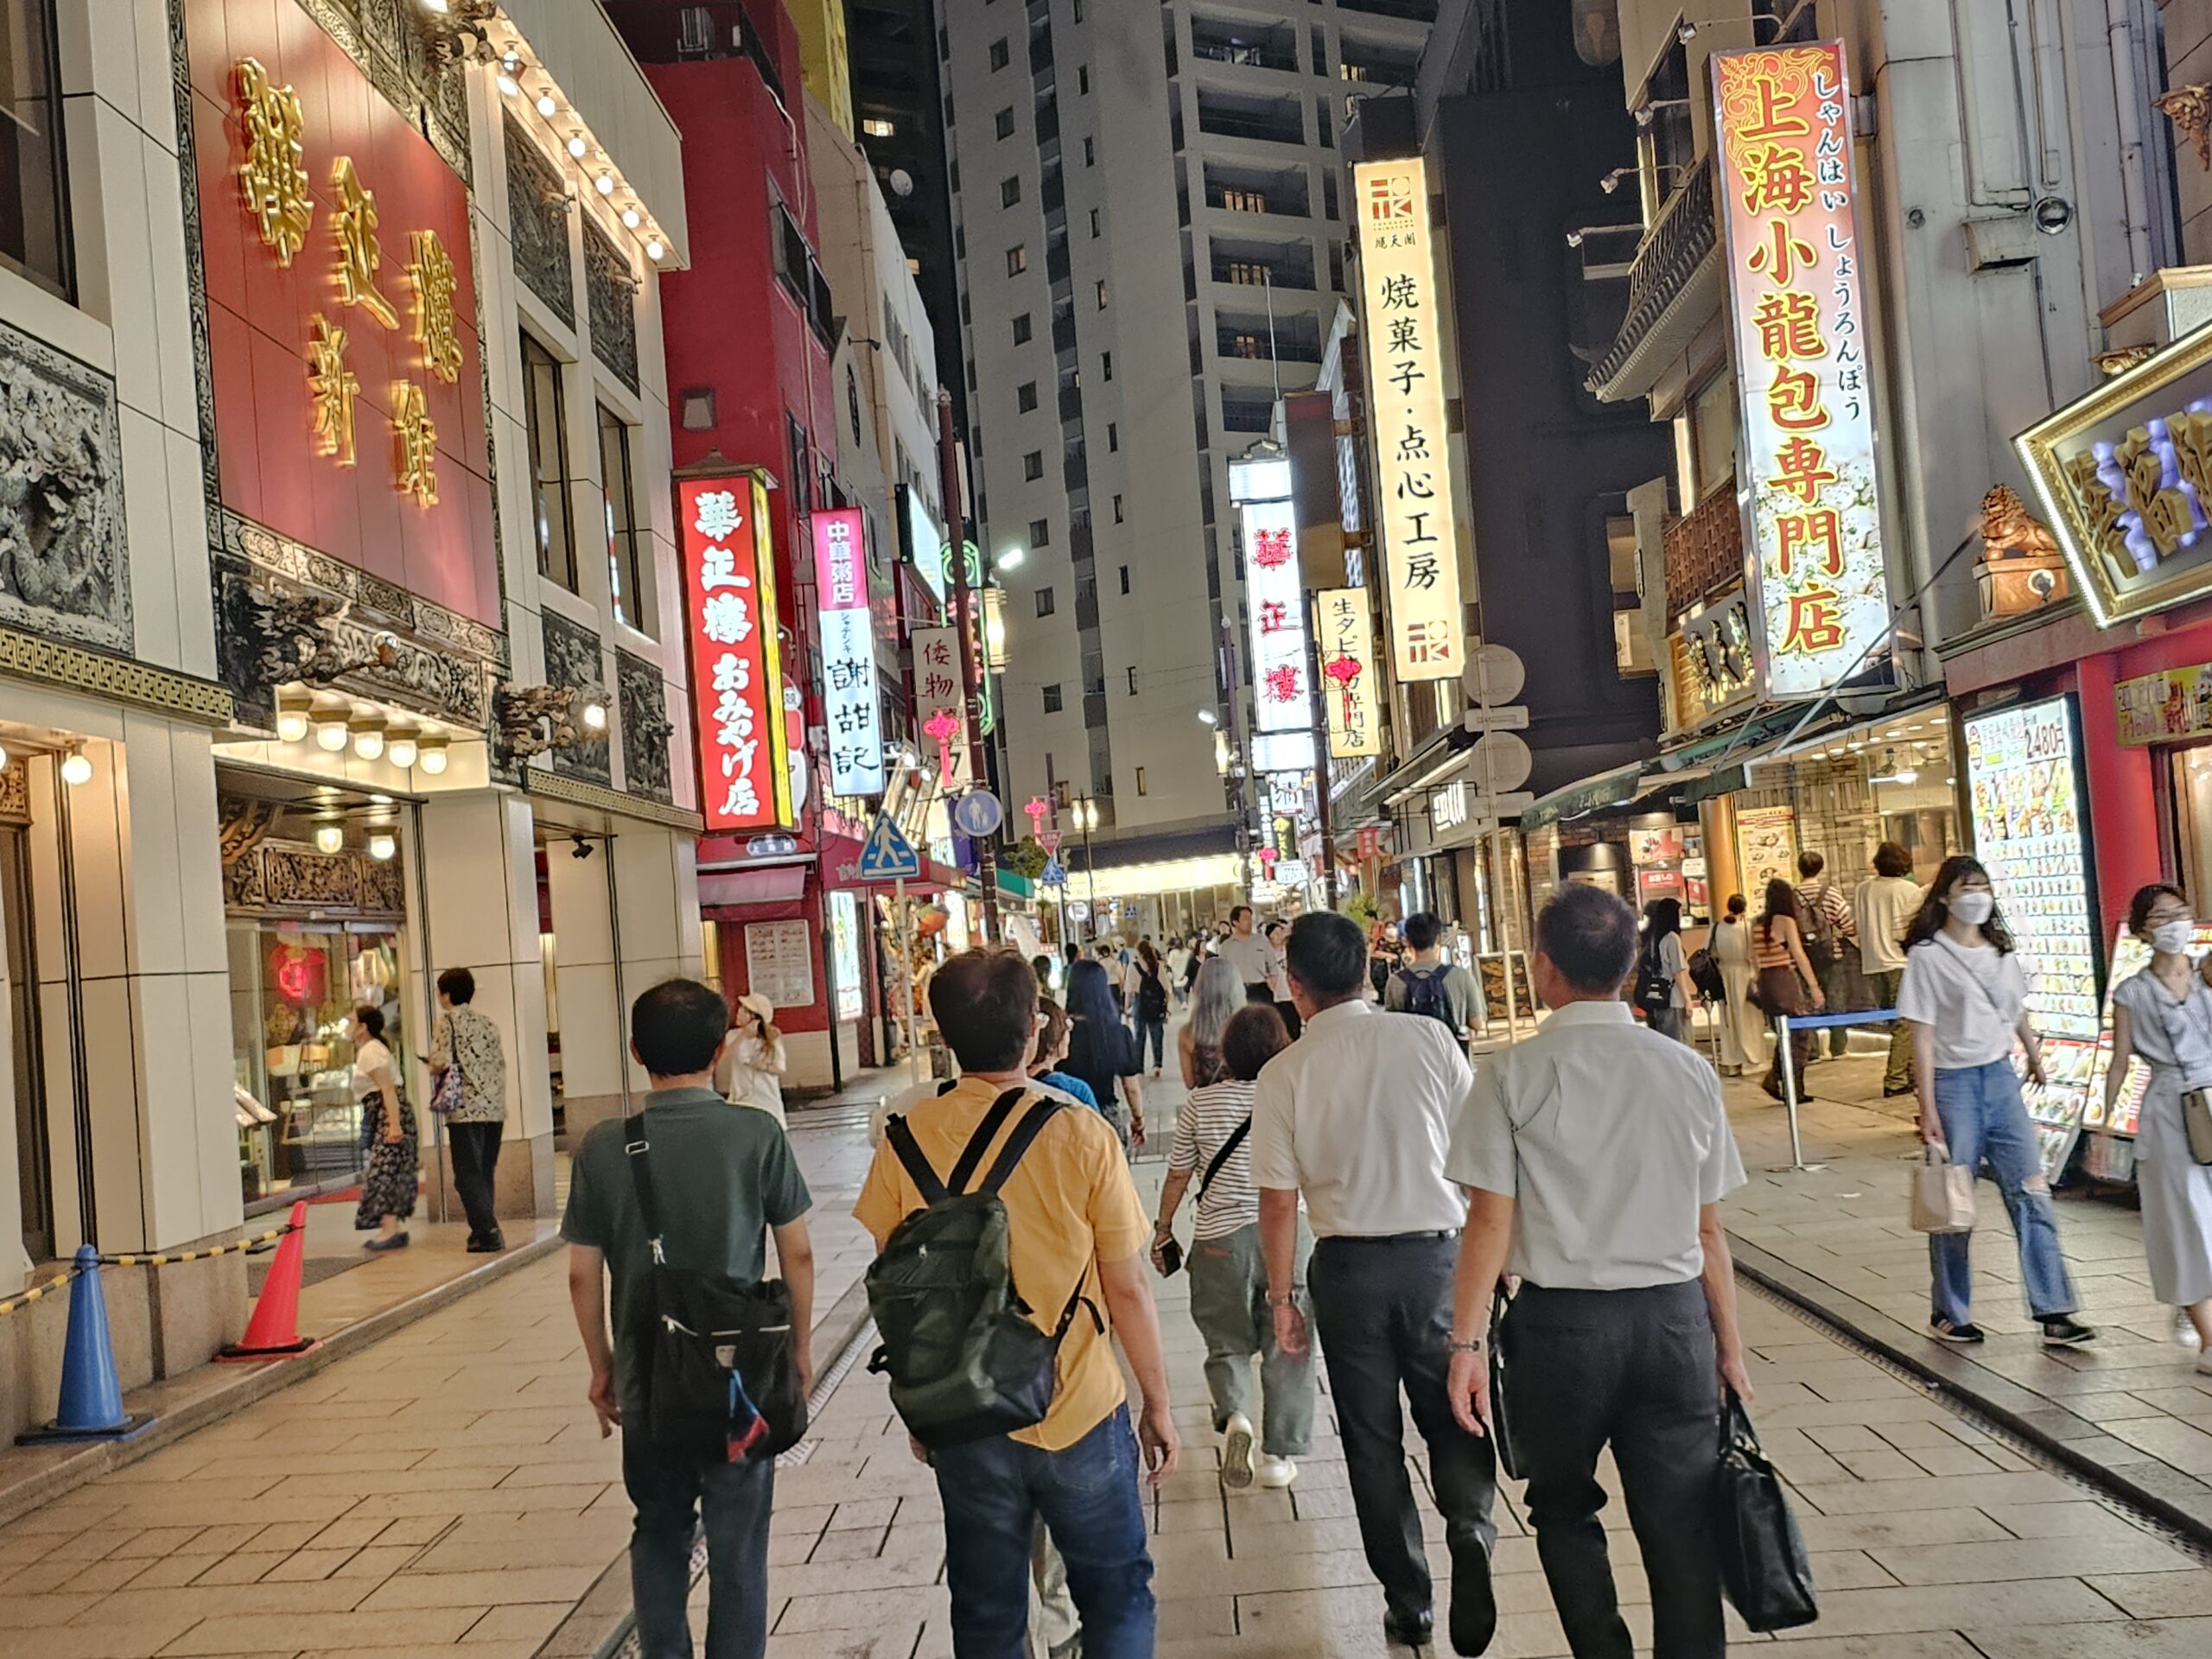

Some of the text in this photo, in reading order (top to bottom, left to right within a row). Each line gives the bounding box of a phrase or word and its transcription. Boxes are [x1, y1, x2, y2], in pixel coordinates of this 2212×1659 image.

[1381, 273, 1440, 590] 焼菓子・点心工房
[1737, 76, 1846, 654] 上海小龍包専門店
[827, 520, 855, 604] 中華粥店
[827, 657, 880, 776] 謝甜記
[1332, 598, 1365, 748] 生タピ専門店
